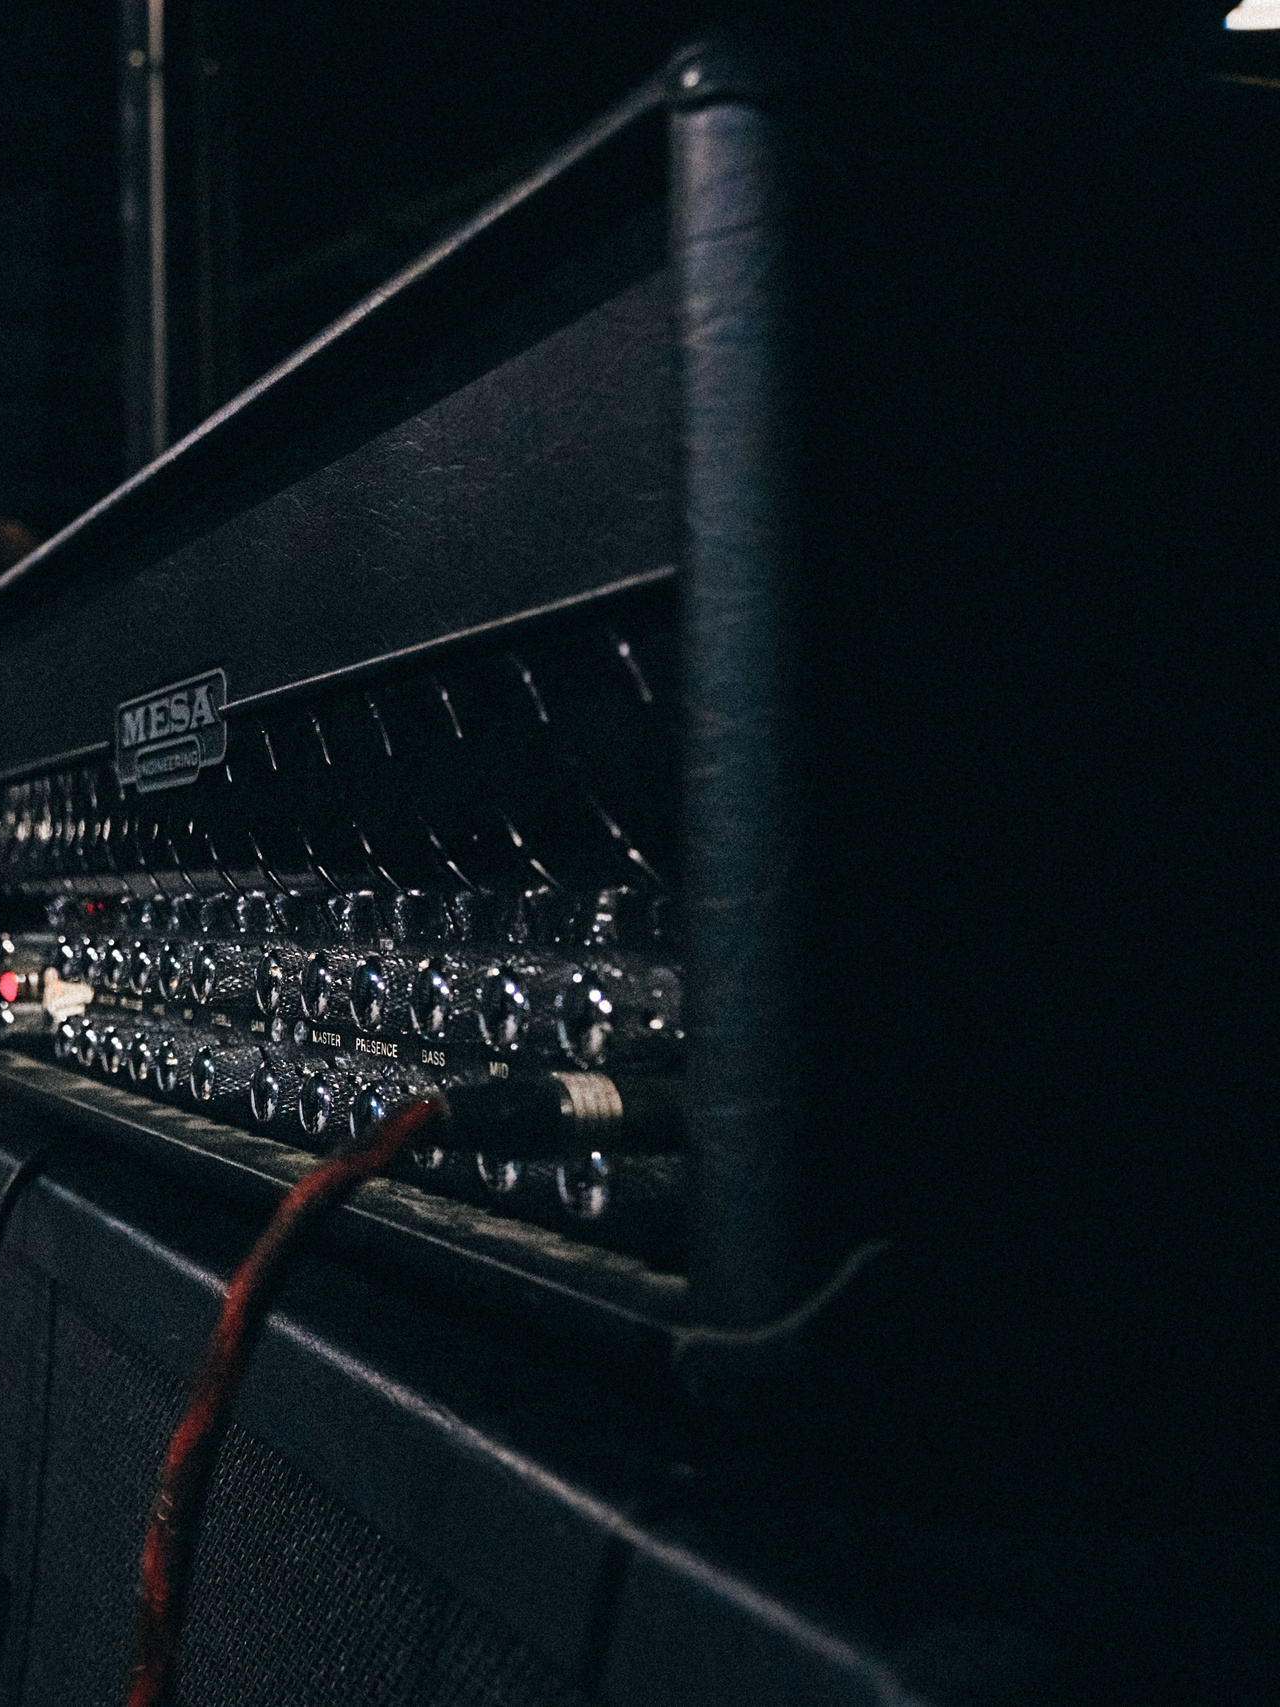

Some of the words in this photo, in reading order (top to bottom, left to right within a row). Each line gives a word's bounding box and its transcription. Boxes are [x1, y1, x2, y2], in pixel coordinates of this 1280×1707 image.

[122, 684, 217, 747] MESA
[355, 1037, 398, 1058] PRESENCE
[421, 1050, 445, 1067] BASS
[489, 1061, 509, 1079] MID
